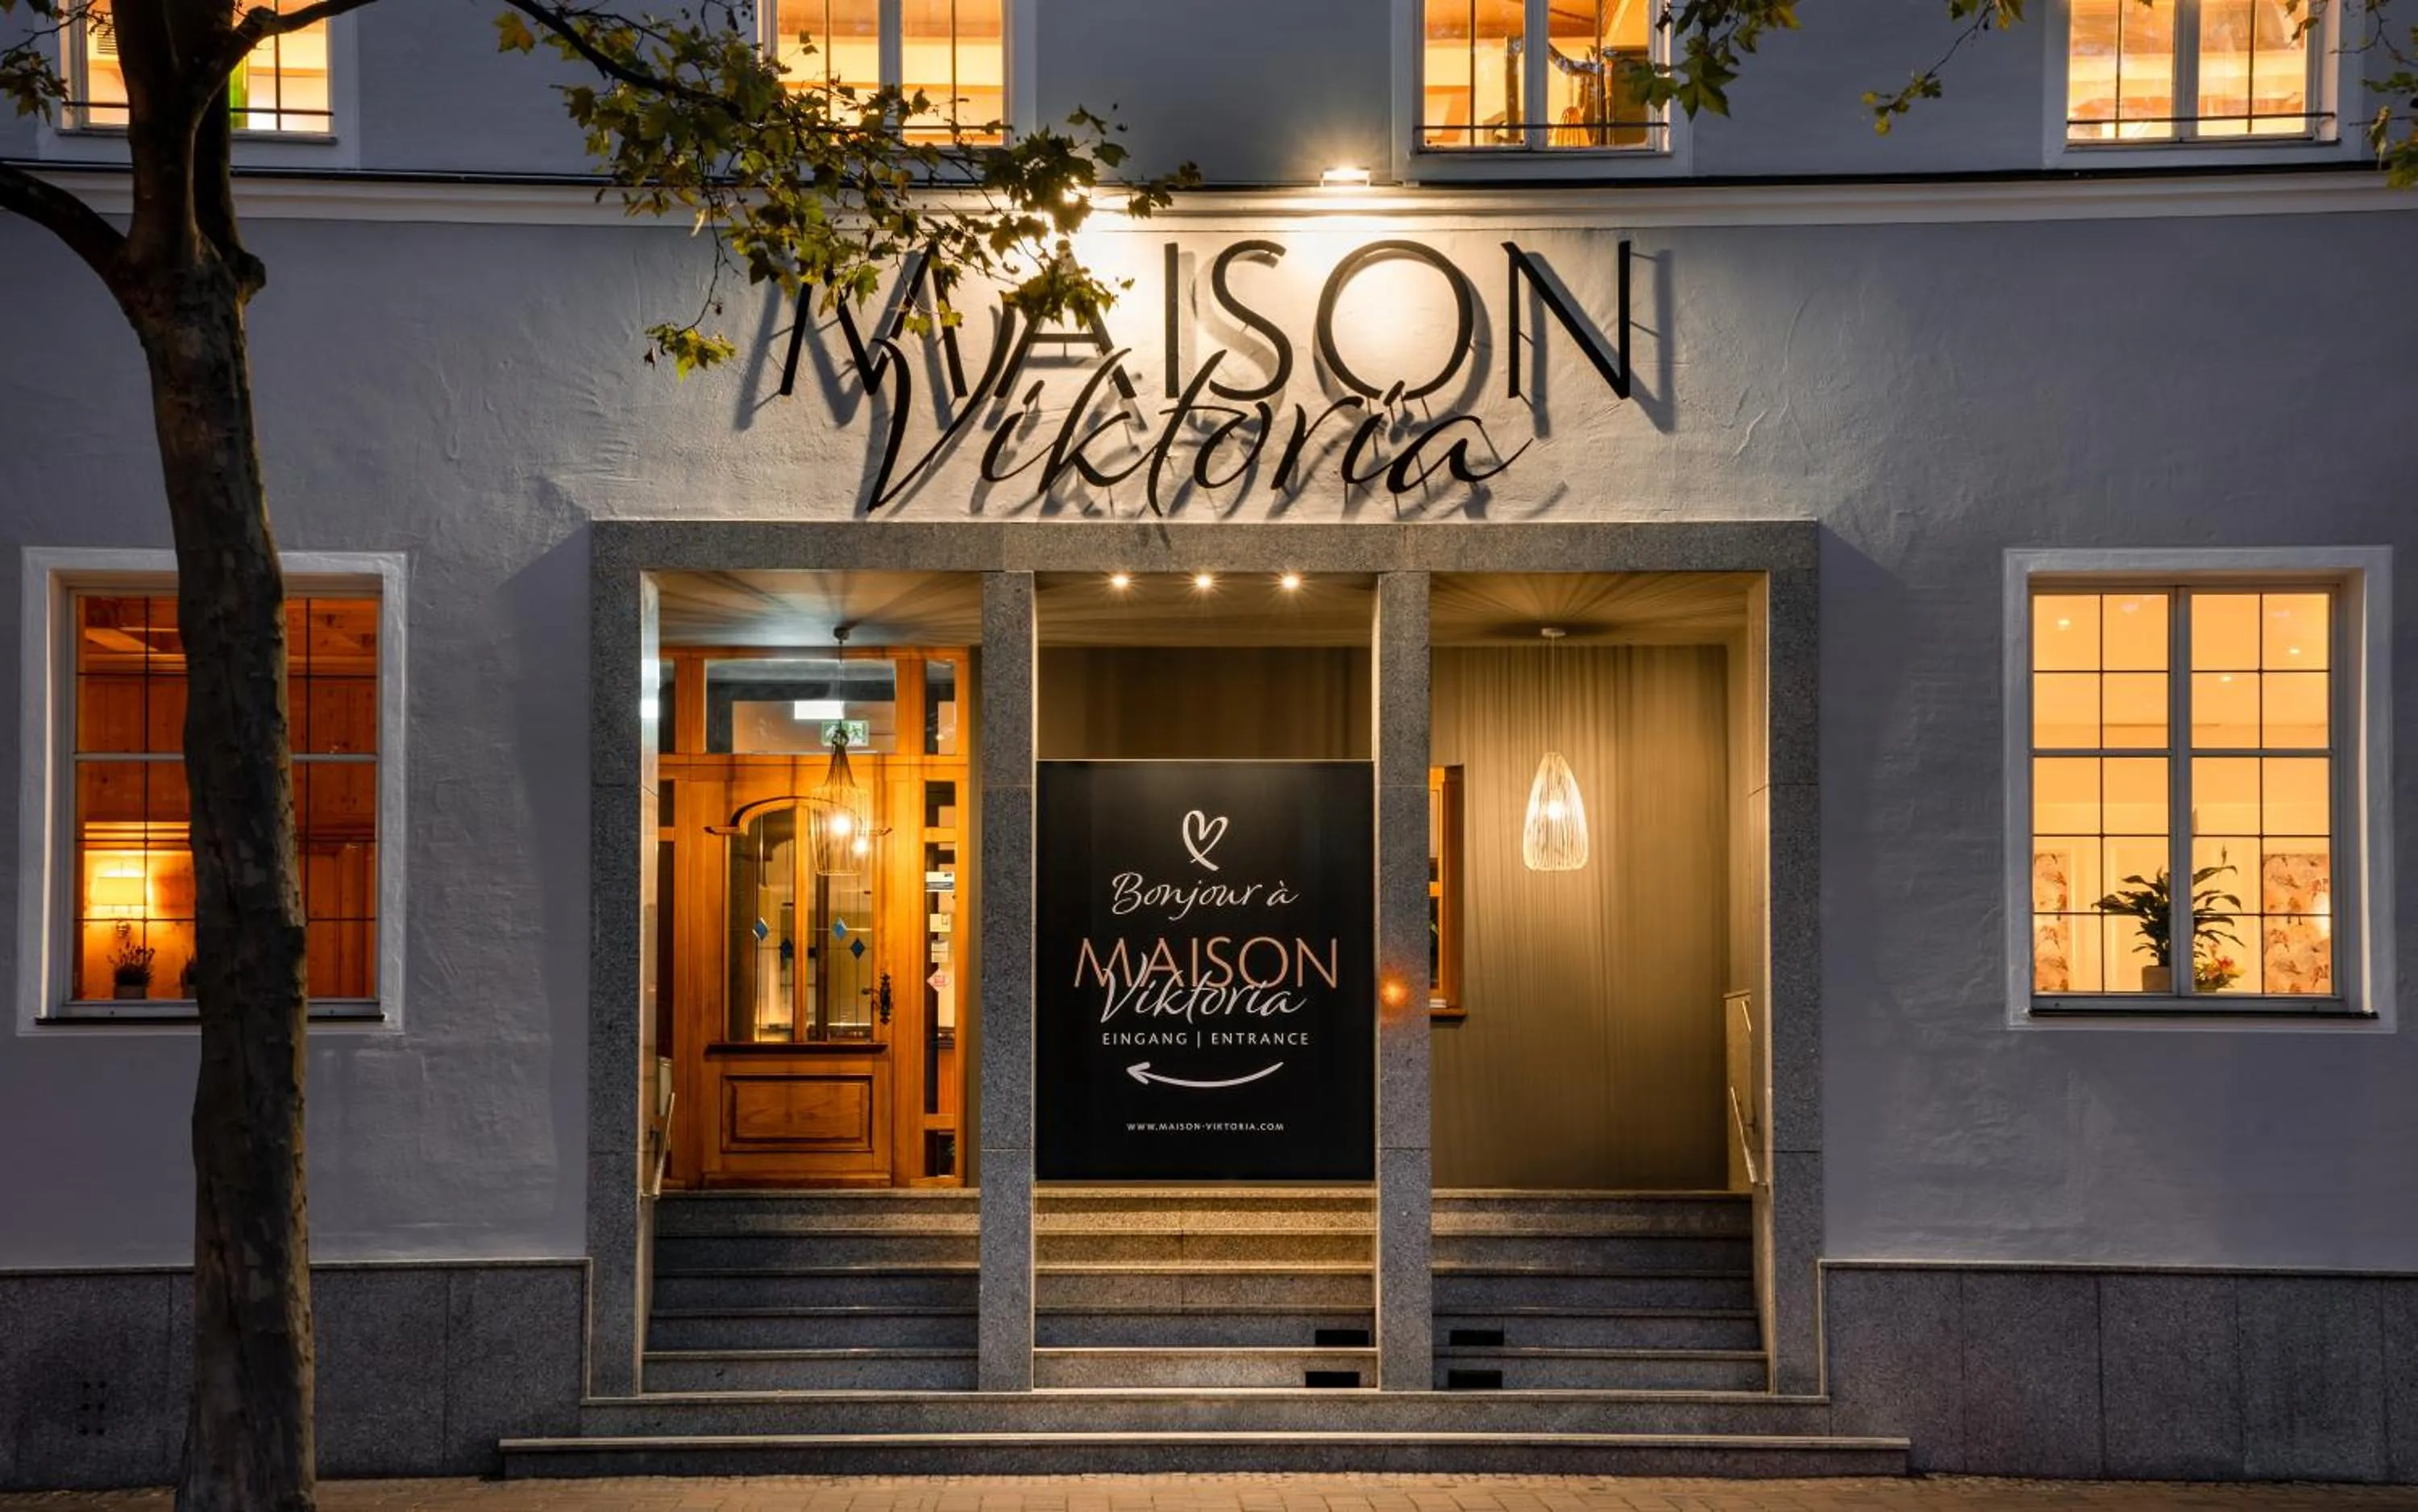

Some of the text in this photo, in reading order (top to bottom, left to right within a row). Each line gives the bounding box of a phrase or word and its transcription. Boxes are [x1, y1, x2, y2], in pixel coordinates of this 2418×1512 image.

[779, 239, 1631, 399] MAISON
[866, 289, 1535, 517] Viktoria
[1111, 871, 1300, 921] Bonjour à
[1074, 936, 1338, 990] MAISON
[1099, 952, 1308, 1024] Viktoria
[1102, 1032, 1189, 1046] EINGANG
[1211, 1032, 1310, 1046] ENTRANCE
[1126, 1122, 1285, 1132] WWW.MAISON-VIKTORIA.COM
